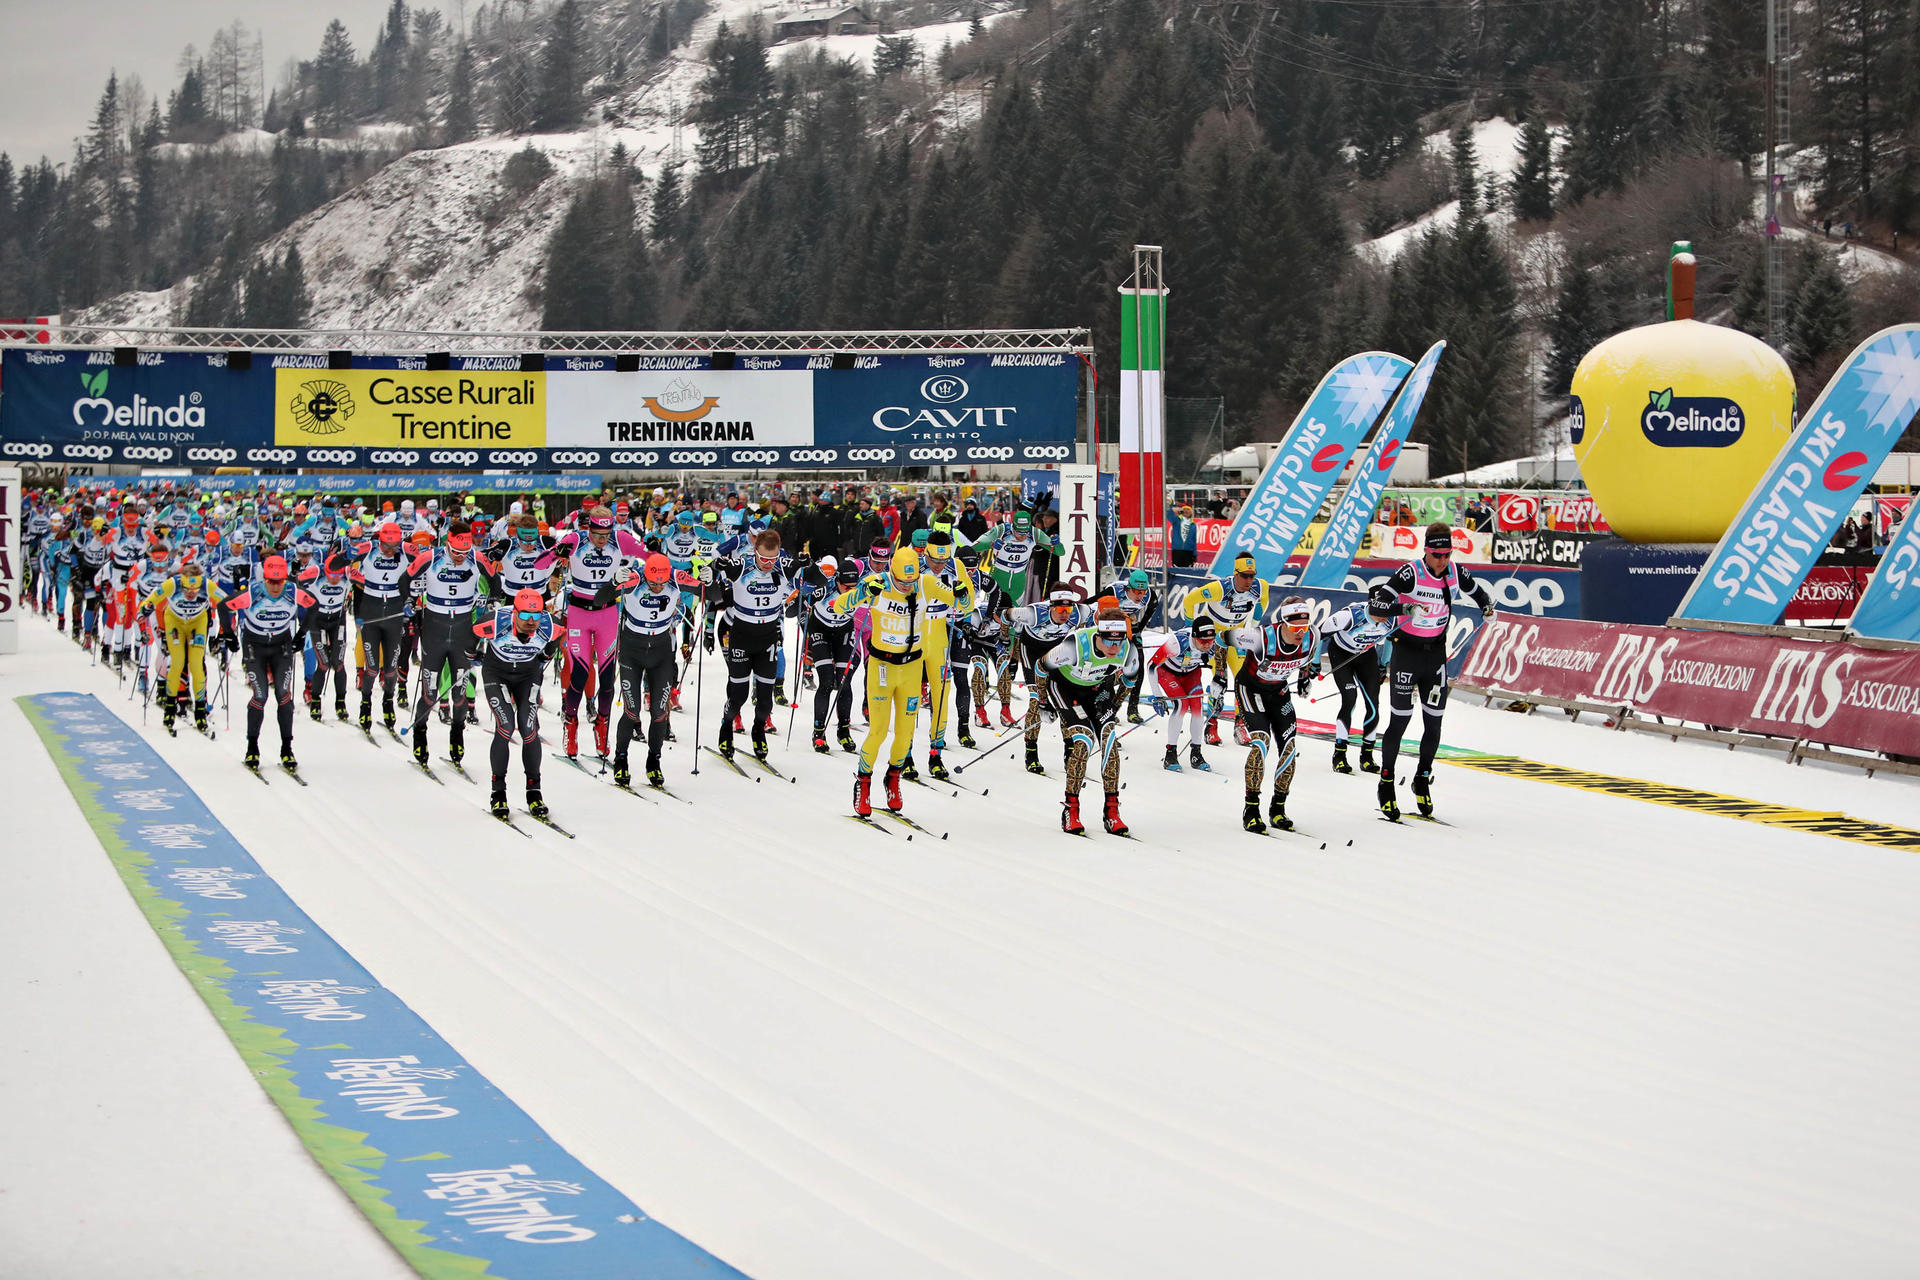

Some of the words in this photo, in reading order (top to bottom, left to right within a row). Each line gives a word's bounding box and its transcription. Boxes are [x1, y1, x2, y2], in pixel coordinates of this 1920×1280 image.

[271, 355, 330, 369] MARCIALON
[462, 357, 522, 370] MARCIALON
[638, 356, 703, 370] ARCIALONGA
[990, 353, 1066, 368] MARCIALONGA
[368, 377, 453, 405] Casse
[459, 378, 535, 405] Rurali
[392, 412, 511, 440] Trentine
[872, 405, 1017, 432] CAVIT
[1645, 407, 1741, 432] Melinda
[111, 431, 137, 442] MELA
[139, 432, 158, 442] VAL
[158, 432, 168, 442] DI
[169, 432, 195, 443] NON
[607, 421, 755, 442] TRENTINGRANA
[911, 431, 981, 440] TRENTO
[1293, 417, 1327, 459] SKI
[1374, 415, 1394, 457] SKI
[1800, 411, 1847, 468] SKI
[3, 441, 54, 459] coop
[63, 443, 113, 461] coop
[123, 445, 173, 463] coop
[187, 446, 237, 464] coop
[247, 448, 297, 465] coop
[306, 449, 357, 466] coop
[731, 450, 780, 466] coop
[789, 449, 838, 464] coop
[847, 447, 896, 463] coop
[909, 447, 958, 463] coop
[967, 446, 1015, 461] coop
[1023, 445, 1070, 461] coop
[370, 450, 420, 467] coop
[430, 450, 479, 467] coop
[489, 451, 538, 467] coop
[551, 451, 601, 467] coop
[610, 451, 660, 467] coop
[669, 451, 718, 467] coop
[1236, 454, 1305, 553] CLASSICS
[1319, 459, 1375, 561] CLASSICS
[1259, 480, 1324, 555] VISMA
[1333, 482, 1384, 560] VISMA
[1713, 461, 1813, 598] CLASSICS
[1007, 554, 1021, 562] 68
[1493, 538, 1538, 561] CRAFT
[1552, 539, 1584, 563] CRA
[1745, 499, 1837, 606] VISMA
[382, 572, 390, 582] 4
[521, 570, 535, 582] 41
[590, 569, 607, 580] 19
[1399, 566, 1414, 582] 157
[1628, 564, 1703, 576] www.melinda.i
[448, 585, 458, 596] 5
[811, 587, 825, 599] 157
[327, 597, 335, 605] 6
[754, 596, 770, 608] 13
[649, 610, 658, 621] 3
[731, 648, 746, 658] 157
[1464, 620, 1541, 685] ITAS
[1270, 660, 1302, 670] MYPAGES
[1592, 633, 1680, 705] ITAS
[1664, 658, 1756, 693] ASSICURAZIONI
[1395, 671, 1413, 684] 157
[1750, 647, 1859, 730] ITAS
[1842, 679, 1920, 715] ASSICURA
[207, 920, 306, 955] TRENTINO
[257, 979, 377, 1024] TRENTINO
[325, 1055, 460, 1121] TRENTINO
[423, 1164, 598, 1245] TRENTINO
